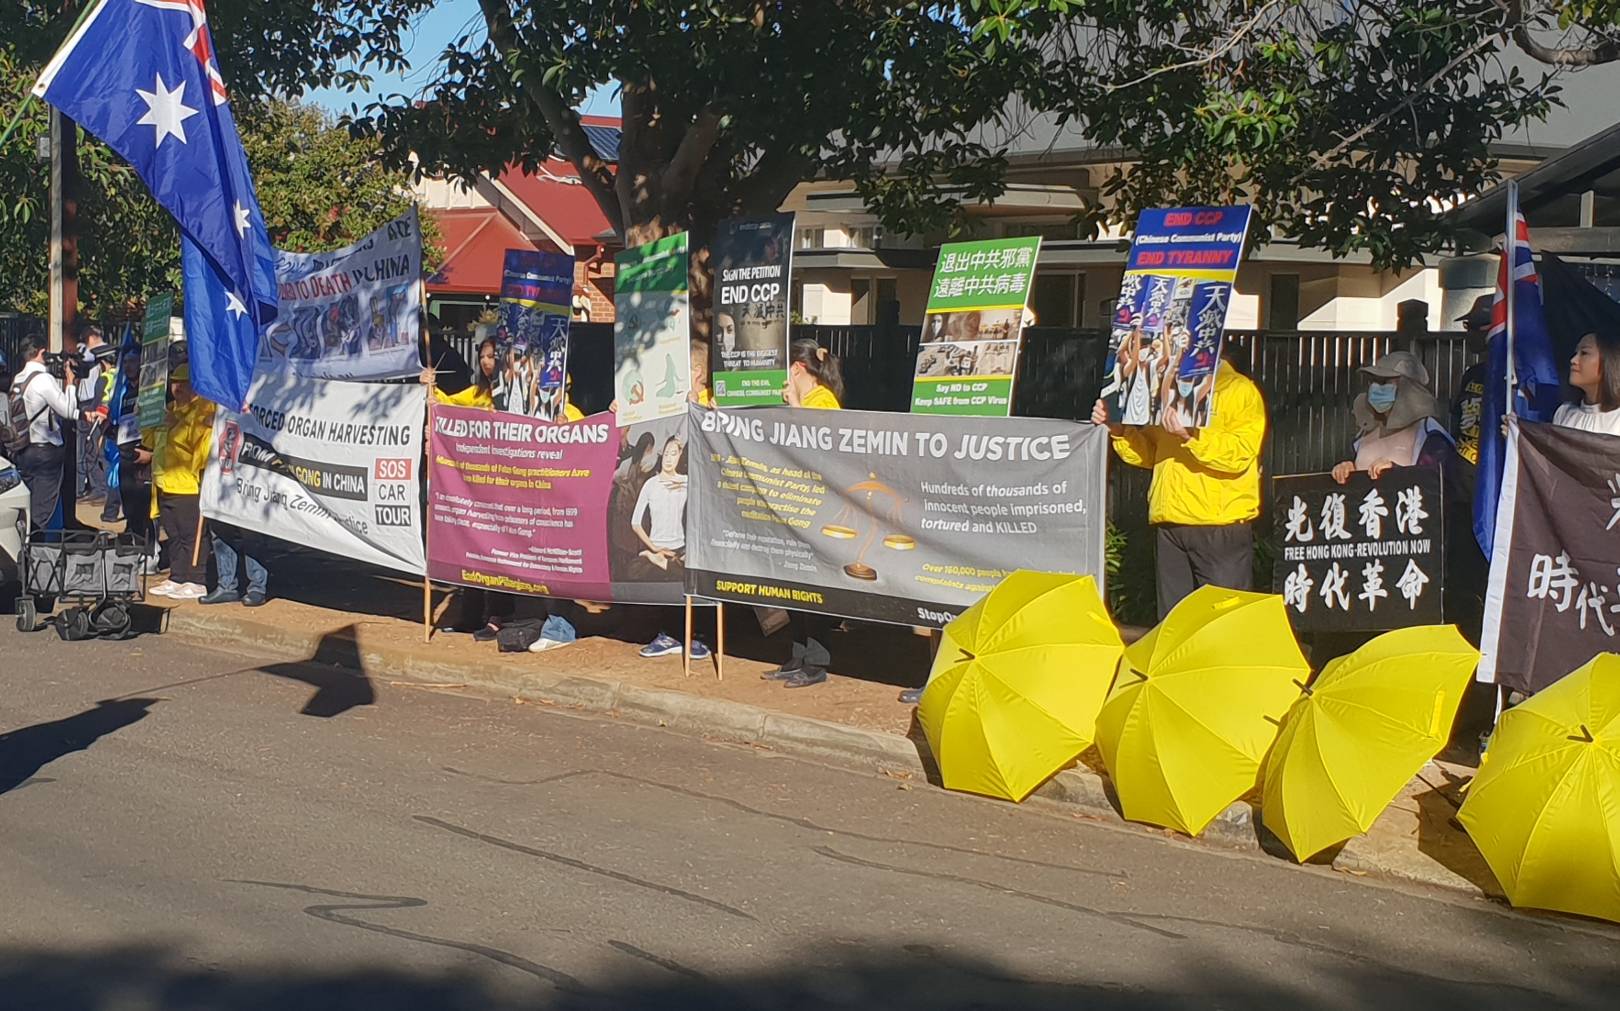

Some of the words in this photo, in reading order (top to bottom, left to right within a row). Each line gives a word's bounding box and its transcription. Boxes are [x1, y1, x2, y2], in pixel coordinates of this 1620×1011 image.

[940, 247, 1033, 273] 退出中共邪黨
[1136, 250, 1165, 265] END
[1167, 249, 1233, 265] TYRANNY
[309, 270, 352, 299] DEATH
[722, 268, 738, 282] SIGN
[739, 267, 751, 281] THE
[751, 264, 781, 280] PETITION
[933, 272, 1028, 298] 遠離中共病毒
[721, 284, 749, 305] END
[750, 282, 780, 303] CCP
[935, 383, 950, 394] Say
[962, 383, 971, 392] to
[287, 415, 327, 441] ORGAN
[328, 423, 411, 446] HARVESTING
[468, 419, 491, 440] FOR
[493, 421, 532, 443] THEIR
[534, 424, 609, 444] ORGANS
[769, 422, 833, 451] JIANG
[838, 428, 908, 456] ZEMIN
[915, 432, 948, 458] TO
[953, 433, 1072, 462] JUSTICE
[536, 448, 563, 460] reveal
[296, 465, 321, 487] GONG
[322, 471, 332, 489] IN
[333, 473, 365, 494] CHINA
[379, 459, 406, 478] SOS
[236, 477, 262, 502] Bring
[378, 483, 406, 501] CAR
[920, 481, 970, 497] Hundreds
[971, 483, 985, 498] of
[985, 482, 1049, 498] thousands
[1052, 480, 1068, 495] of
[375, 506, 411, 525] TOUR
[970, 504, 1009, 518] people
[1284, 484, 1430, 543] 光復香港
[920, 517, 970, 532] tortured
[971, 521, 994, 534] and
[995, 521, 1037, 534] KILLED
[1284, 546, 1305, 561] FREE
[1306, 544, 1330, 560] HONG
[1410, 538, 1432, 554] NOW
[716, 579, 758, 595] SUPPORT
[758, 584, 791, 600] HUMAN
[791, 589, 824, 604] RIGHTS
[1283, 558, 1430, 614] 時代革命
[1526, 549, 1620, 637] 時代
